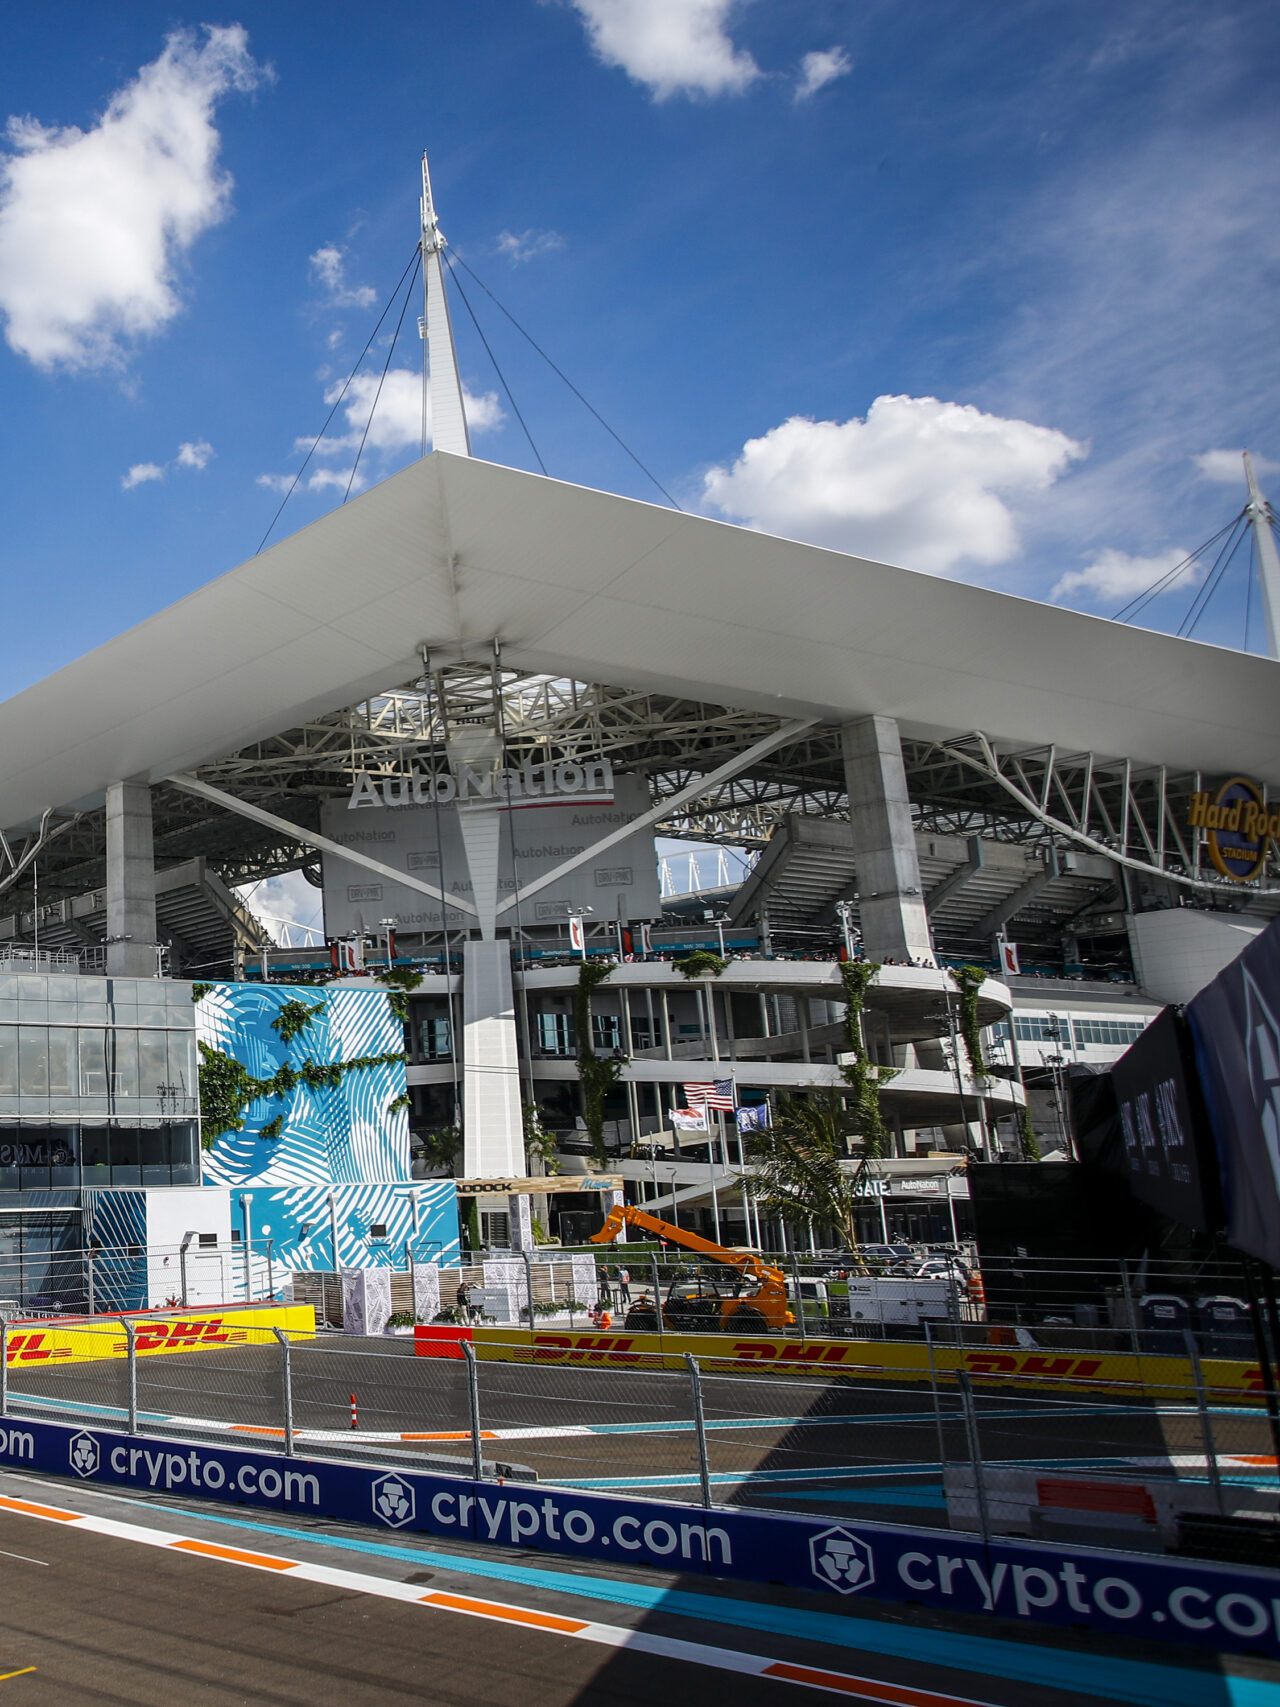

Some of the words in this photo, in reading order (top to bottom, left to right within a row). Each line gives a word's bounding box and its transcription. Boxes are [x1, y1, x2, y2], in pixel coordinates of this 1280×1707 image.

[347, 757, 615, 809] AutoNation
[1187, 792, 1244, 831] Hard
[1243, 800, 1280, 842] Roc
[1223, 847, 1258, 862] STADIUM
[901, 1180, 940, 1191] AutoNation
[133, 1319, 228, 1351] DHL
[533, 1335, 644, 1362] DHL
[731, 1343, 857, 1370] DHL
[964, 1354, 1110, 1386] DHL
[110, 1446, 321, 1505] crypto.com
[431, 1491, 733, 1566] crypto.com
[897, 1550, 1280, 1643] crypto.co
